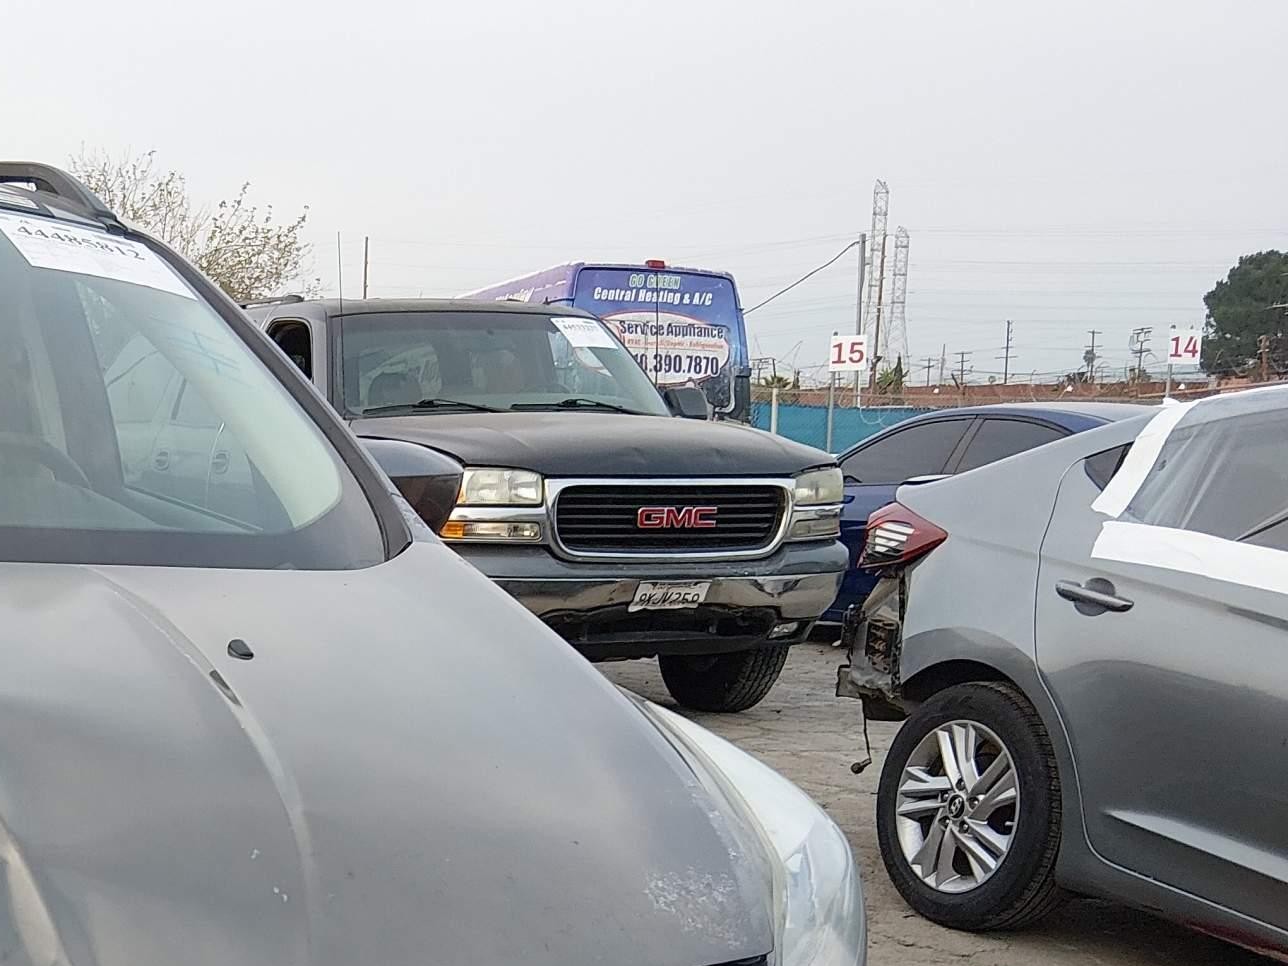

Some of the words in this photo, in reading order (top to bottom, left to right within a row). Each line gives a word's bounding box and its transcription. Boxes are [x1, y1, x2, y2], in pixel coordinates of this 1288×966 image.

[629, 273, 645, 288] GO
[593, 287, 637, 302] Central
[638, 288, 681, 304] Heating
[683, 292, 690, 304] &
[692, 292, 713, 306] A/C
[619, 320, 665, 337] Service
[666, 322, 724, 339] Appliance
[832, 342, 864, 364] 15
[1169, 336, 1199, 358] 14
[637, 507, 718, 529] GMC
